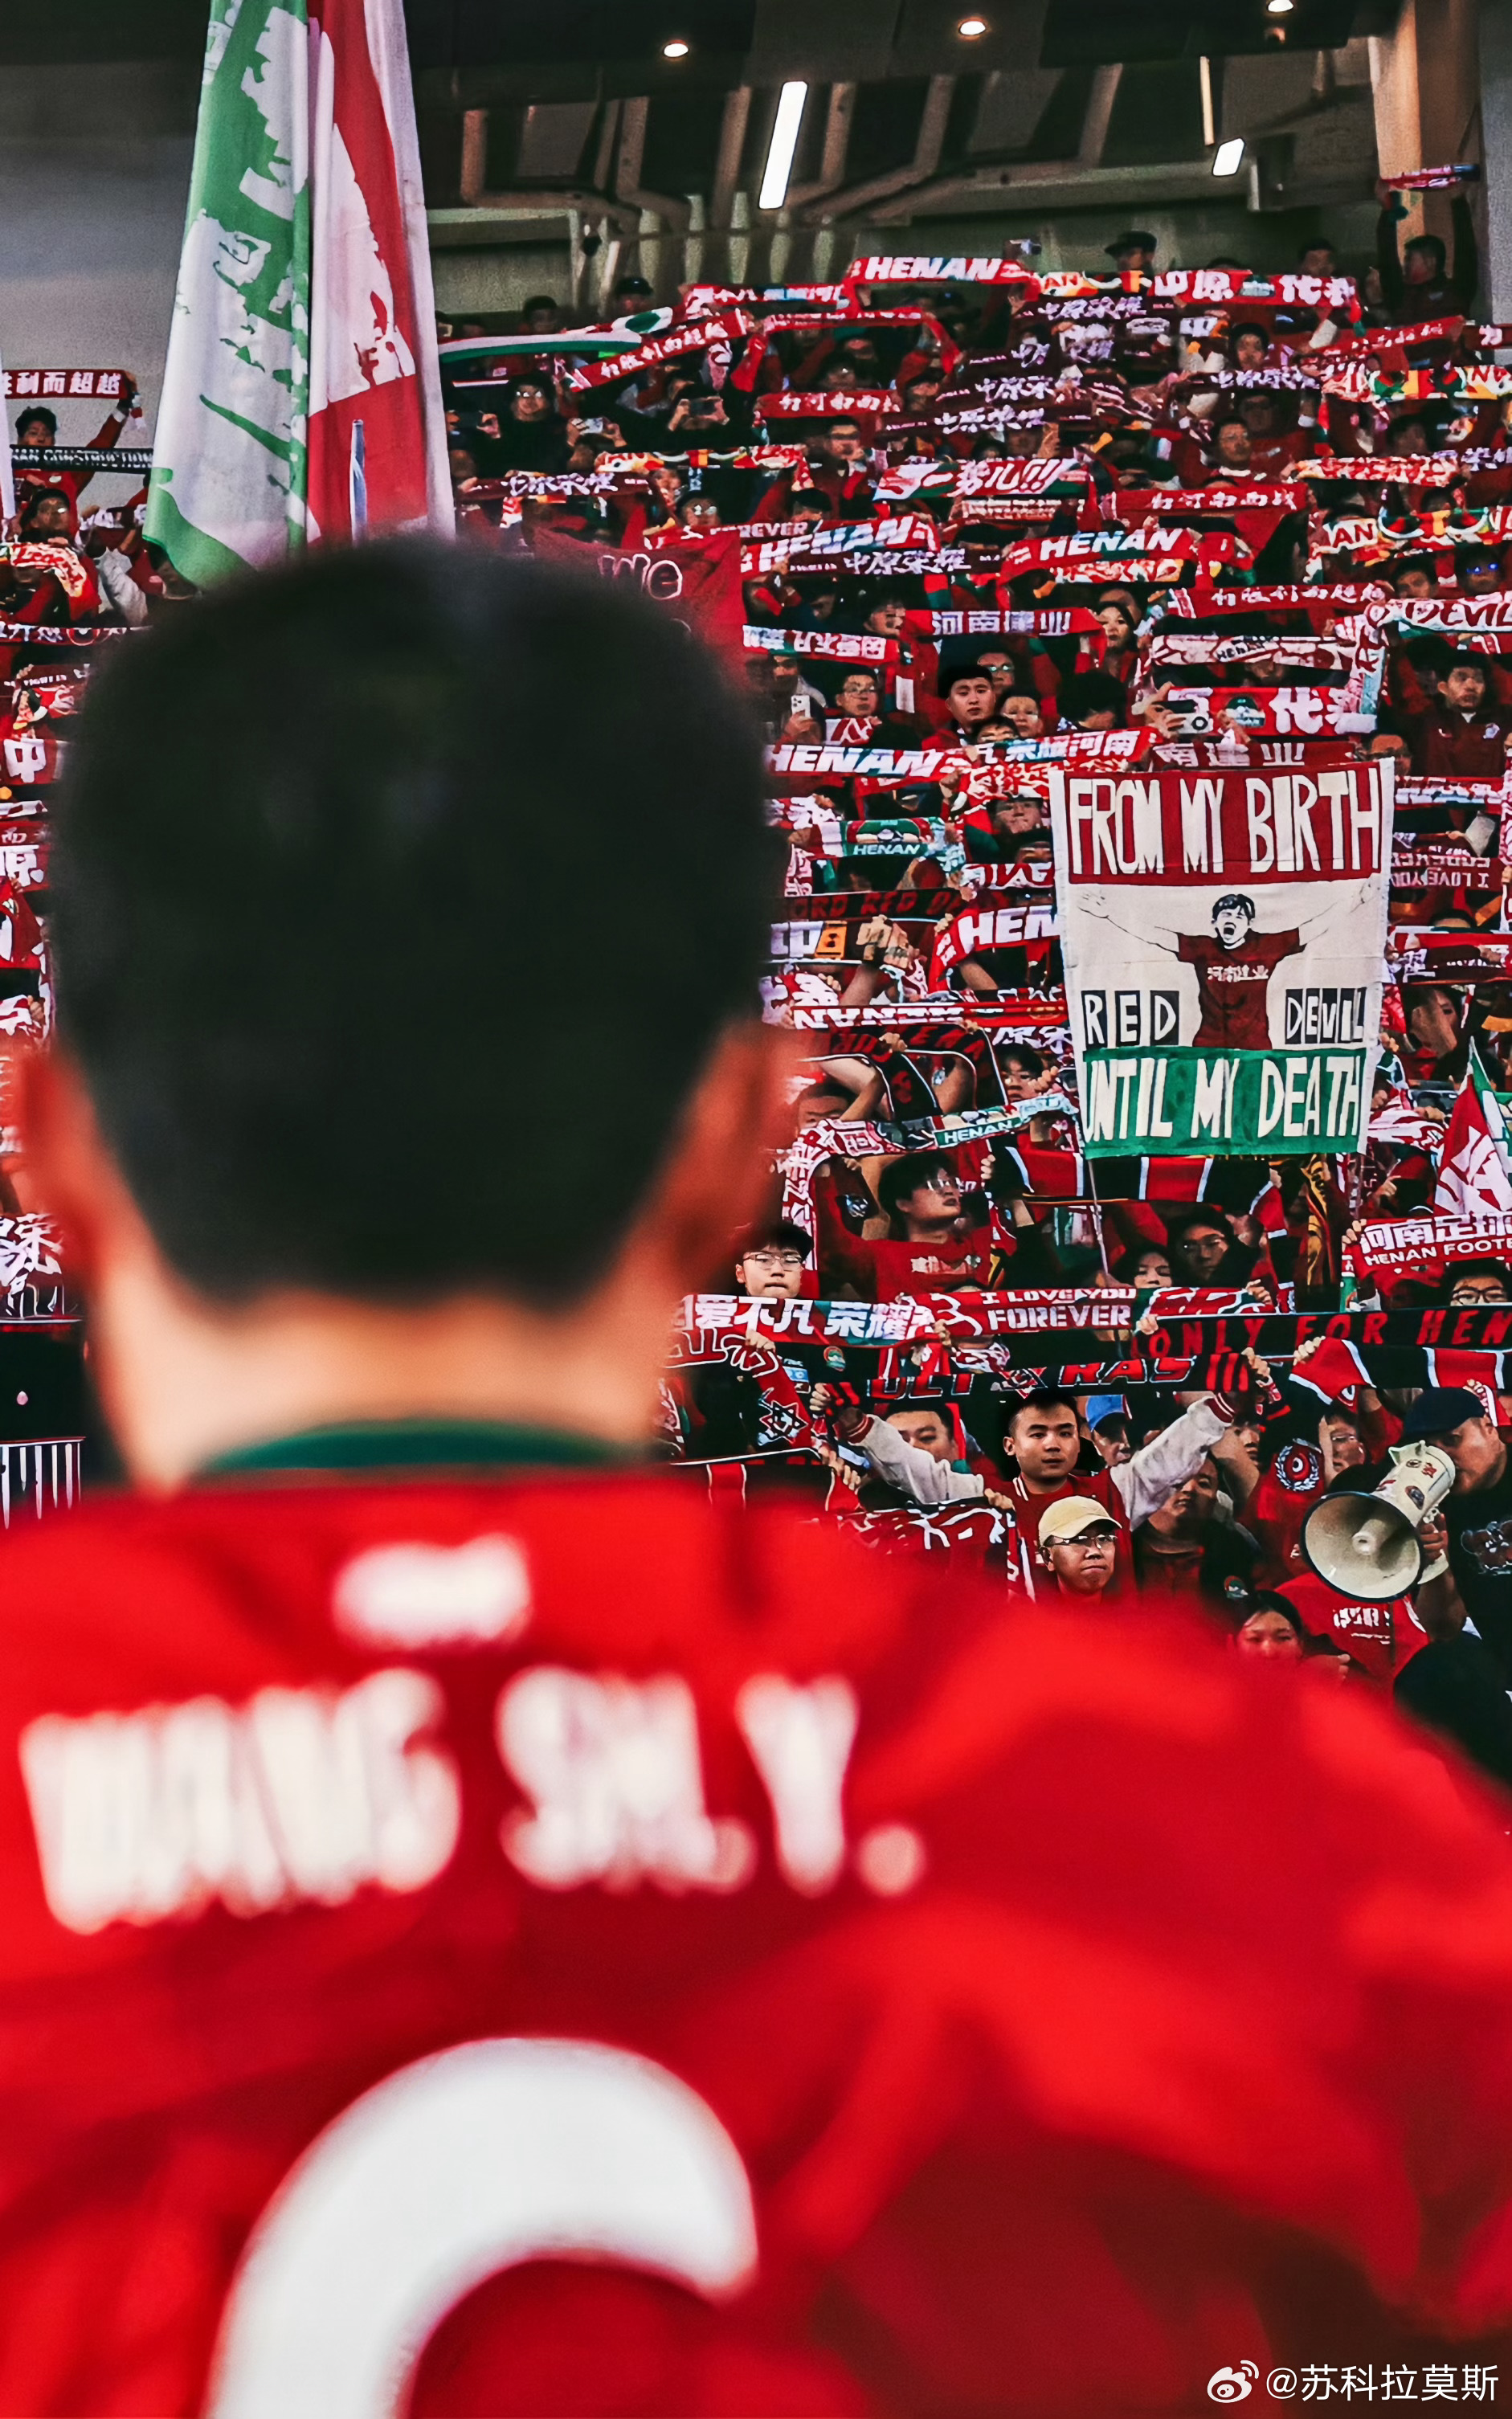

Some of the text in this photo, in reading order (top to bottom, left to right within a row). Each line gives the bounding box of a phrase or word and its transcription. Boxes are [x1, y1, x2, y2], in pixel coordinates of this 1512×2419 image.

[864, 256, 1003, 280] HENAN
[759, 517, 913, 572] HENAN
[1040, 528, 1183, 561] HENAN
[766, 744, 944, 778] HENAN
[1069, 770, 1380, 875] FROM MY BIRTH
[853, 844, 921, 856] HENAN
[1085, 989, 1363, 1044] RED DEVIL
[1085, 1056, 1361, 1142] UNTIL MY DEATH
[944, 1119, 1013, 1144] HENAN
[1364, 1246, 1437, 1266] HENAN
[980, 1288, 1137, 1305] I LOVE YOU
[987, 1305, 1132, 1330] FOREVER
[1149, 1309, 1512, 1359] ONLY FOR HEN
